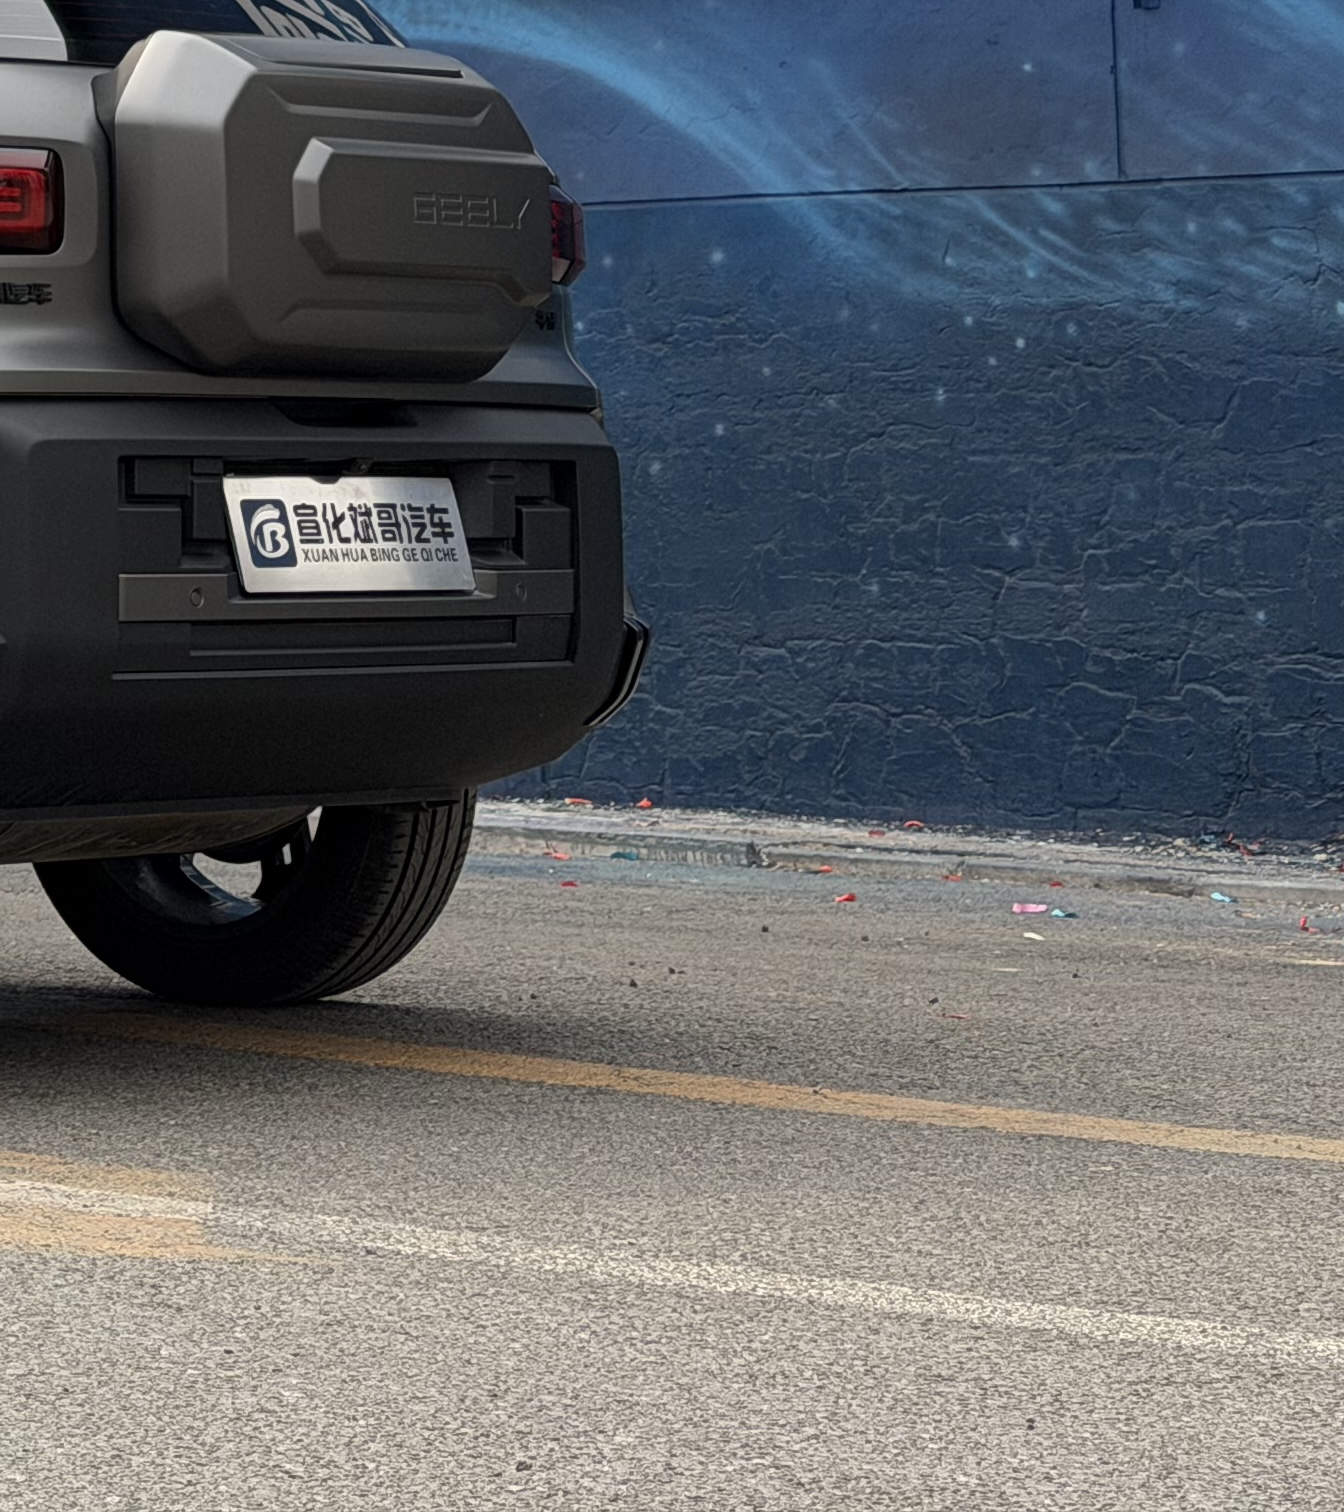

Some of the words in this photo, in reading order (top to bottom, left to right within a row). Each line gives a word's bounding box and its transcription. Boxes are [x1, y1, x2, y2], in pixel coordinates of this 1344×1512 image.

[413, 192, 530, 229] GEELY
[293, 502, 455, 544] 宣化斌哥汽车
[301, 547, 339, 562] XUAN
[341, 547, 369, 562] HUA
[370, 547, 400, 562] BING
[402, 547, 419, 562] GE
[420, 547, 433, 562] QI
[435, 547, 459, 562] CHE
